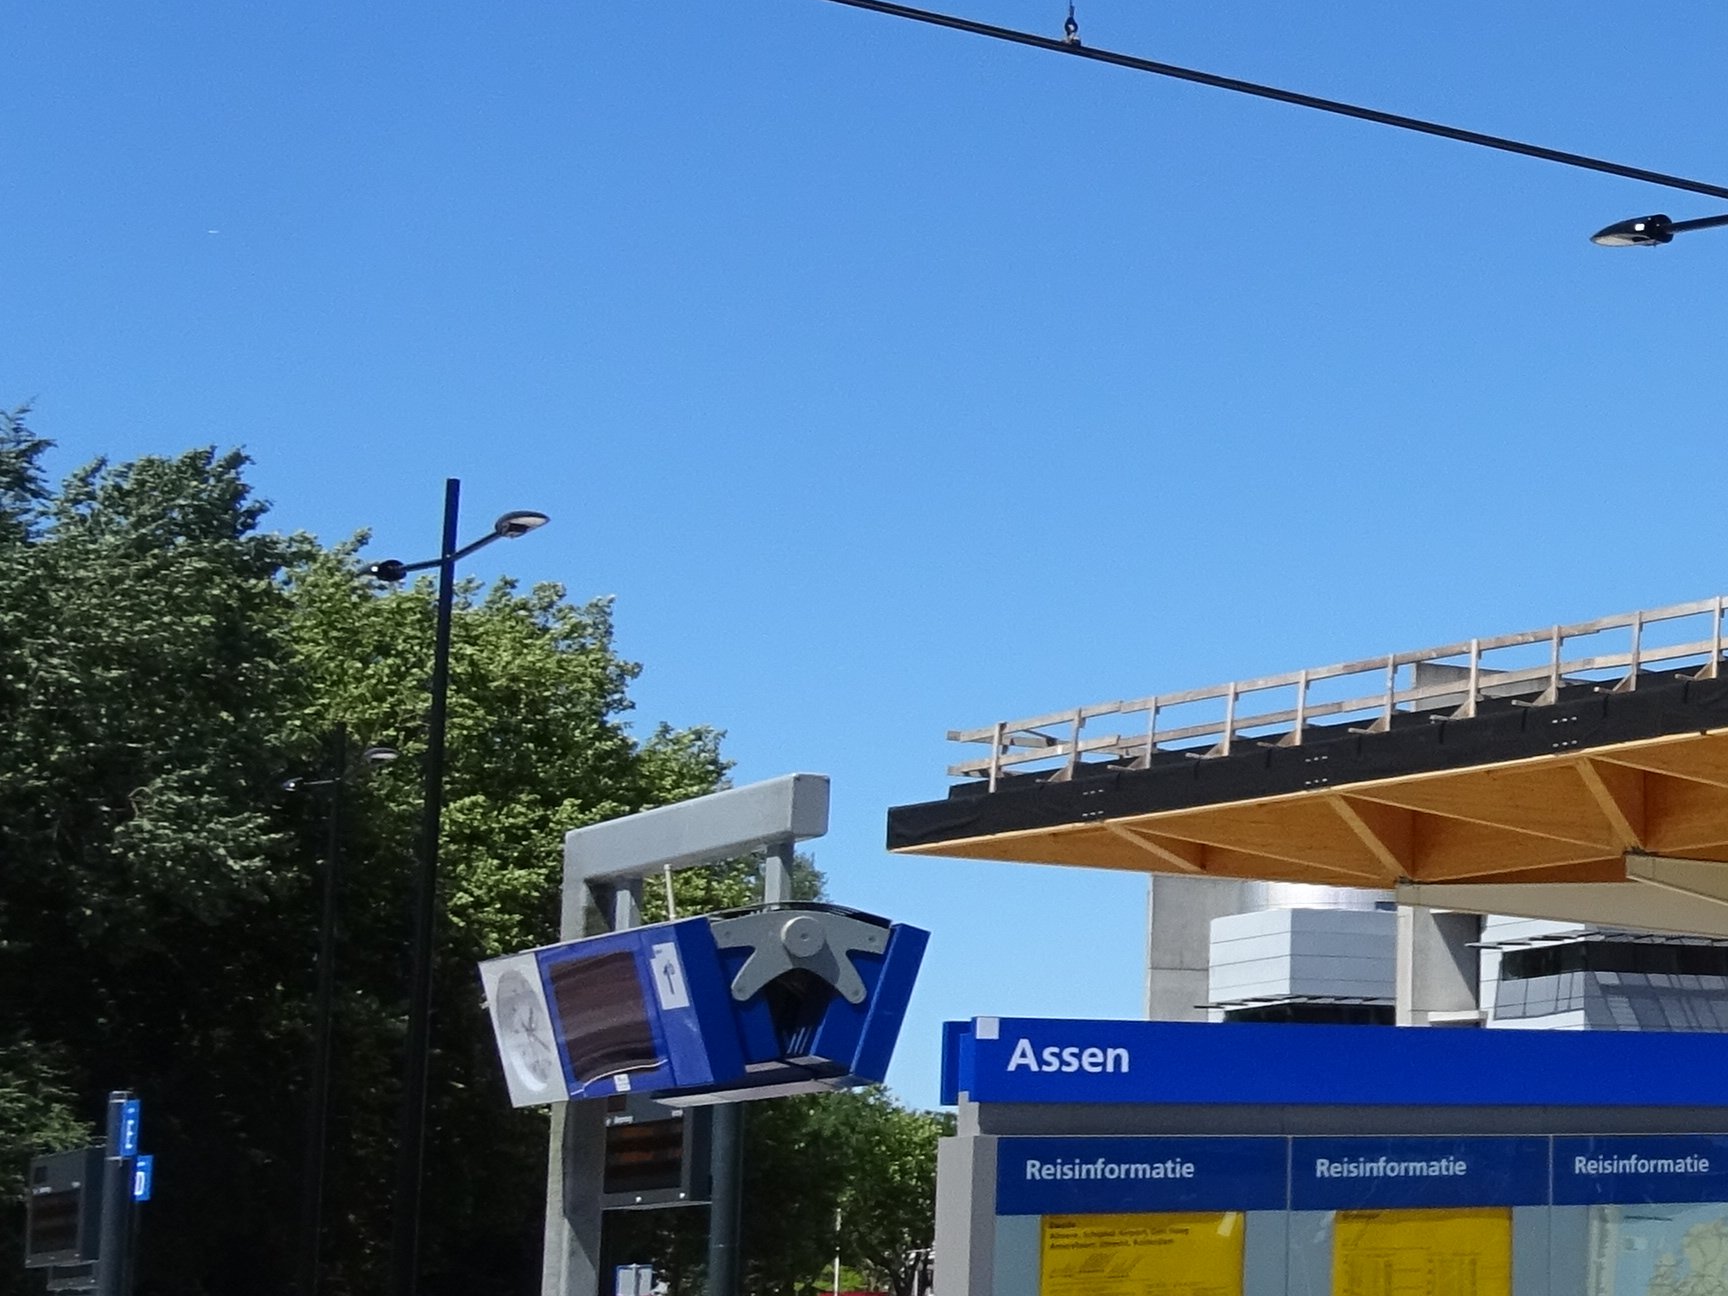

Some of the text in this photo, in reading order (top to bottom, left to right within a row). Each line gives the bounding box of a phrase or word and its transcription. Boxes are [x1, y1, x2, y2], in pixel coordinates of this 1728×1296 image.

[1007, 1038, 1130, 1073] Assen
[1025, 1158, 1195, 1181] Reisinformatie
[1315, 1155, 1468, 1178] Reisinformatie
[1573, 1153, 1710, 1174] Reisinformatie
